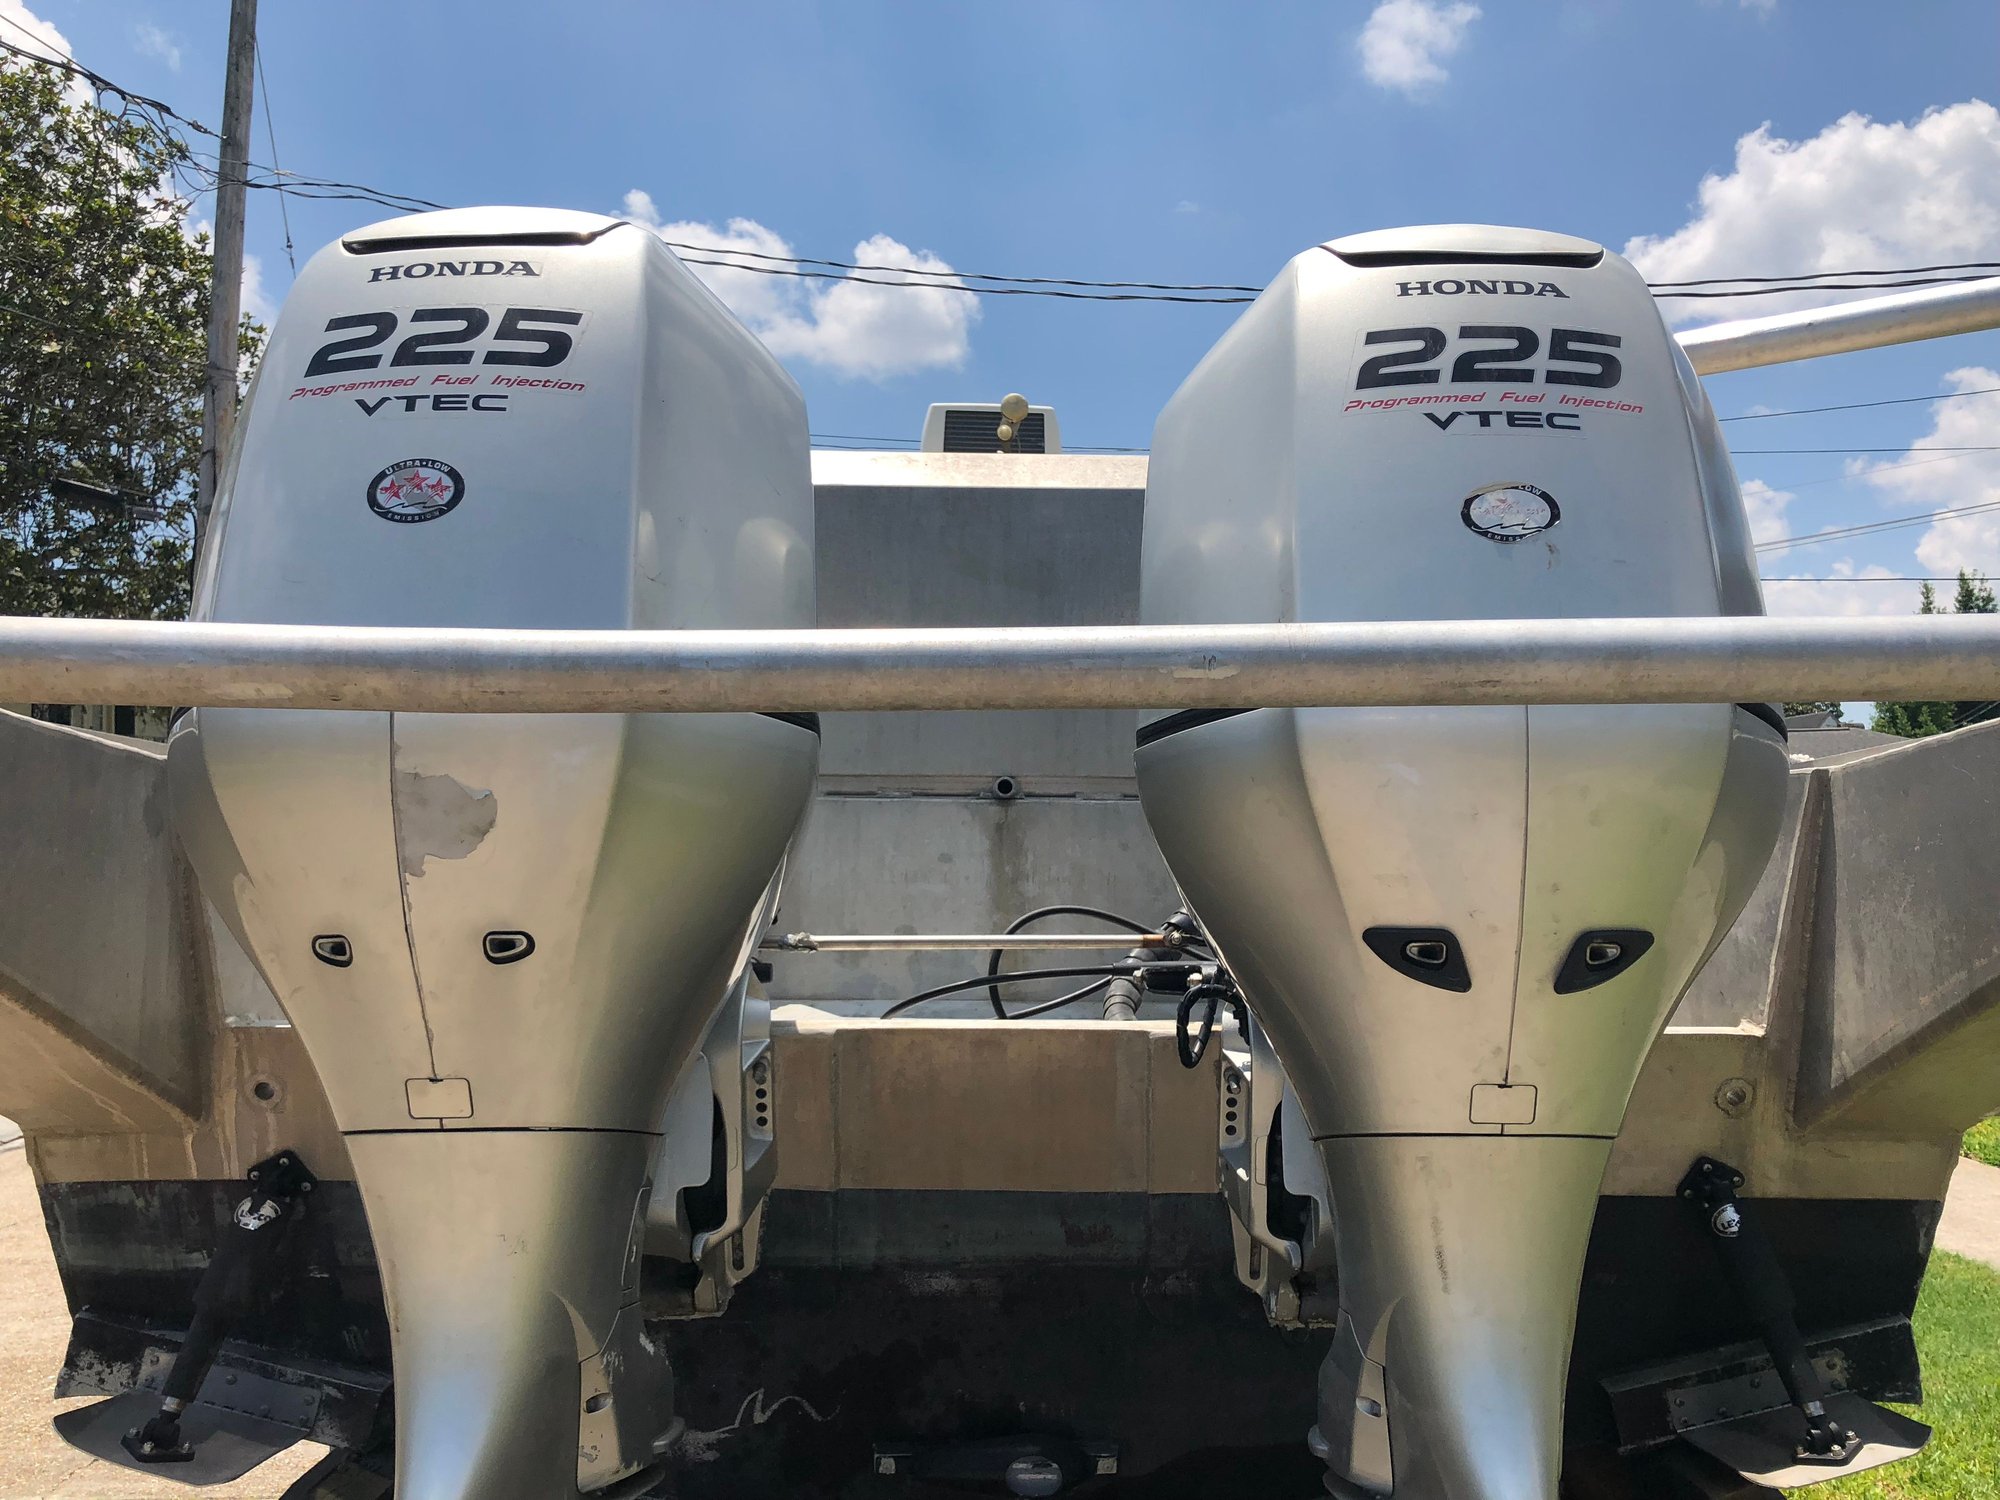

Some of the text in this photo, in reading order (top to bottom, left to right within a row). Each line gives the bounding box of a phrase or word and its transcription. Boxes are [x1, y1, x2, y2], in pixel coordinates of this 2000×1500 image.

[367, 261, 540, 283] HONDA
[1395, 279, 1571, 299] HONDA
[304, 307, 584, 379] 225
[1356, 325, 1622, 391] 225
[288, 374, 586, 401] Programmed Fuel Injection
[354, 394, 509, 417] VTEC
[1343, 391, 1643, 414] Programmed Fuel Injection
[1423, 410, 1581, 431] VTEC
[387, 509, 441, 521] EMISSION
